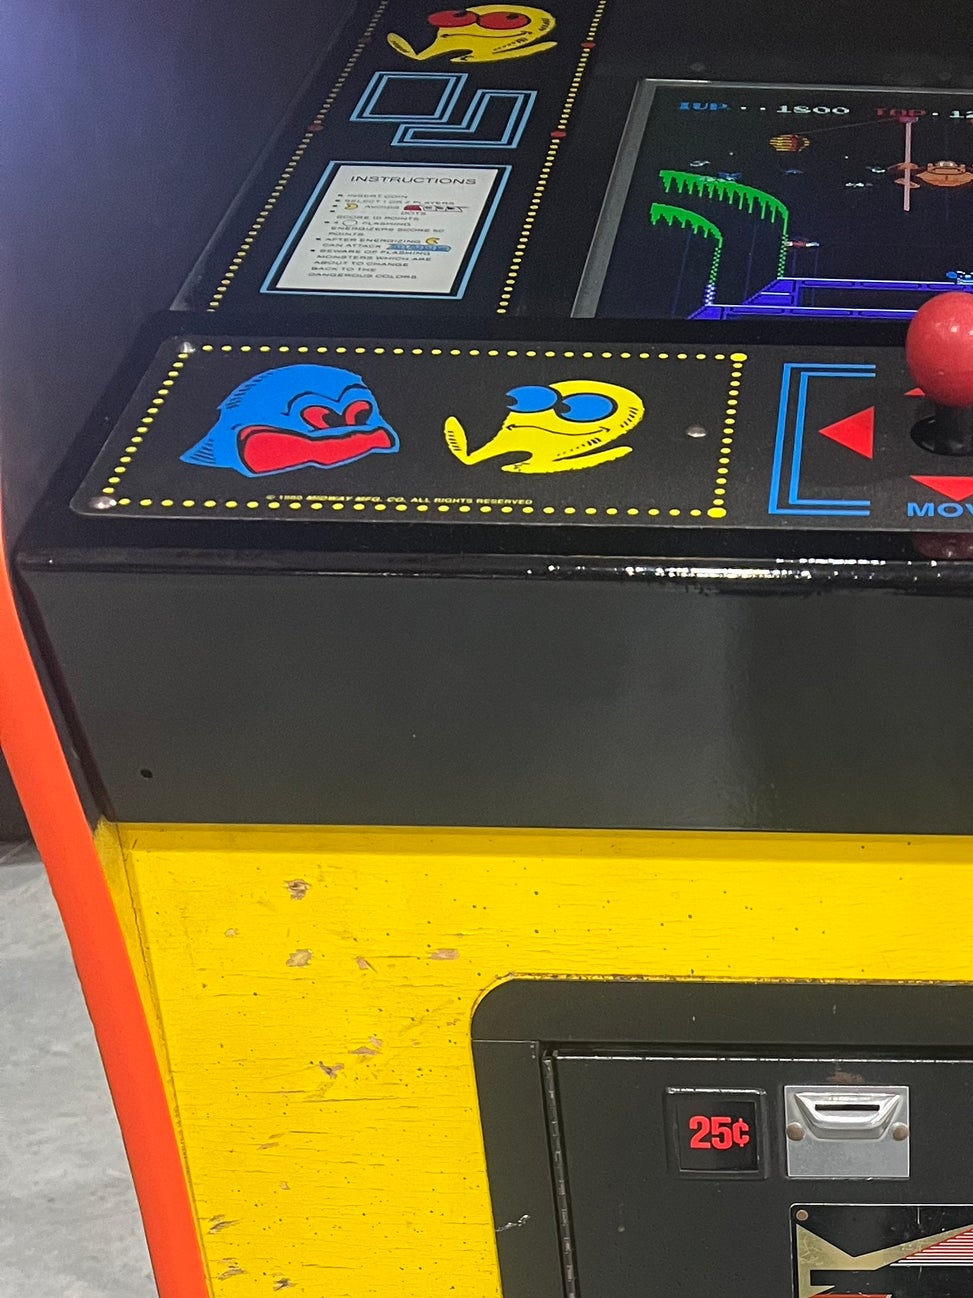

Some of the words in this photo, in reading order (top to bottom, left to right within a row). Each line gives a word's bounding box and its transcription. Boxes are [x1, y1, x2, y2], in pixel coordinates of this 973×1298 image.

[776, 105, 850, 115] 1800
[350, 175, 477, 185] INSTRUCTIONS
[306, 494, 354, 502] MIDWAY
[475, 498, 533, 506] RESERVED
[688, 1115, 750, 1150] 25¢
